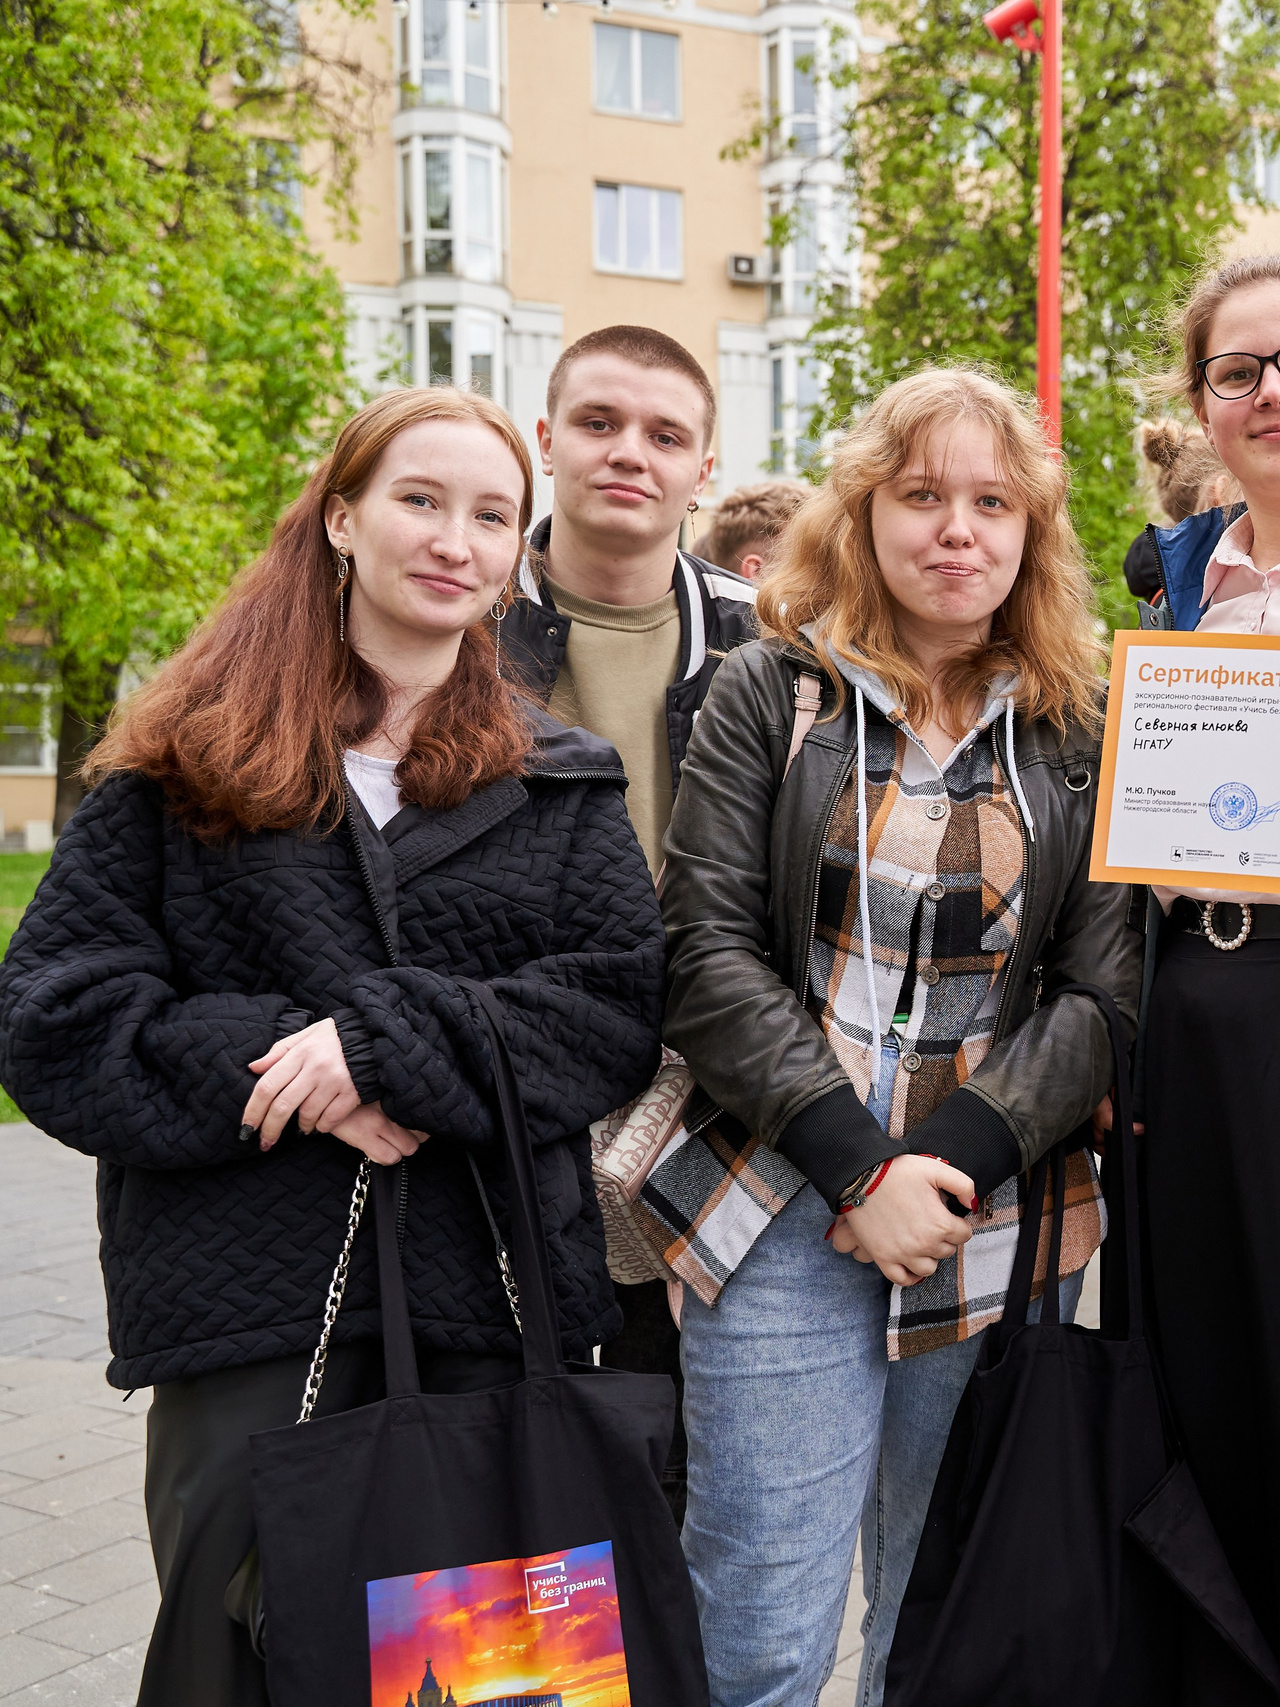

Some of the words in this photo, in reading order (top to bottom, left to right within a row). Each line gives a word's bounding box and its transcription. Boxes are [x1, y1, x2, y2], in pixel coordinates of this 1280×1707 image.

[1134, 692, 1257, 704] экскурсионно-познавательной
[1133, 702, 1193, 711] регионального
[1194, 702, 1237, 712] фестиваля
[1239, 705, 1267, 714] «Учись
[1134, 717, 1198, 732] Северная
[1201, 719, 1249, 733] клюква
[1133, 737, 1173, 750] НГАТУ
[1125, 786, 1145, 795] М.Ю.
[1146, 787, 1176, 797] Пучков
[1124, 797, 1151, 806] Министр
[1152, 798, 1192, 807] образования
[1123, 804, 1171, 813] Нижегородской
[1172, 807, 1198, 815] области
[532, 1574, 568, 1591] учись
[540, 1587, 561, 1599] без
[563, 1576, 607, 1595] границ
